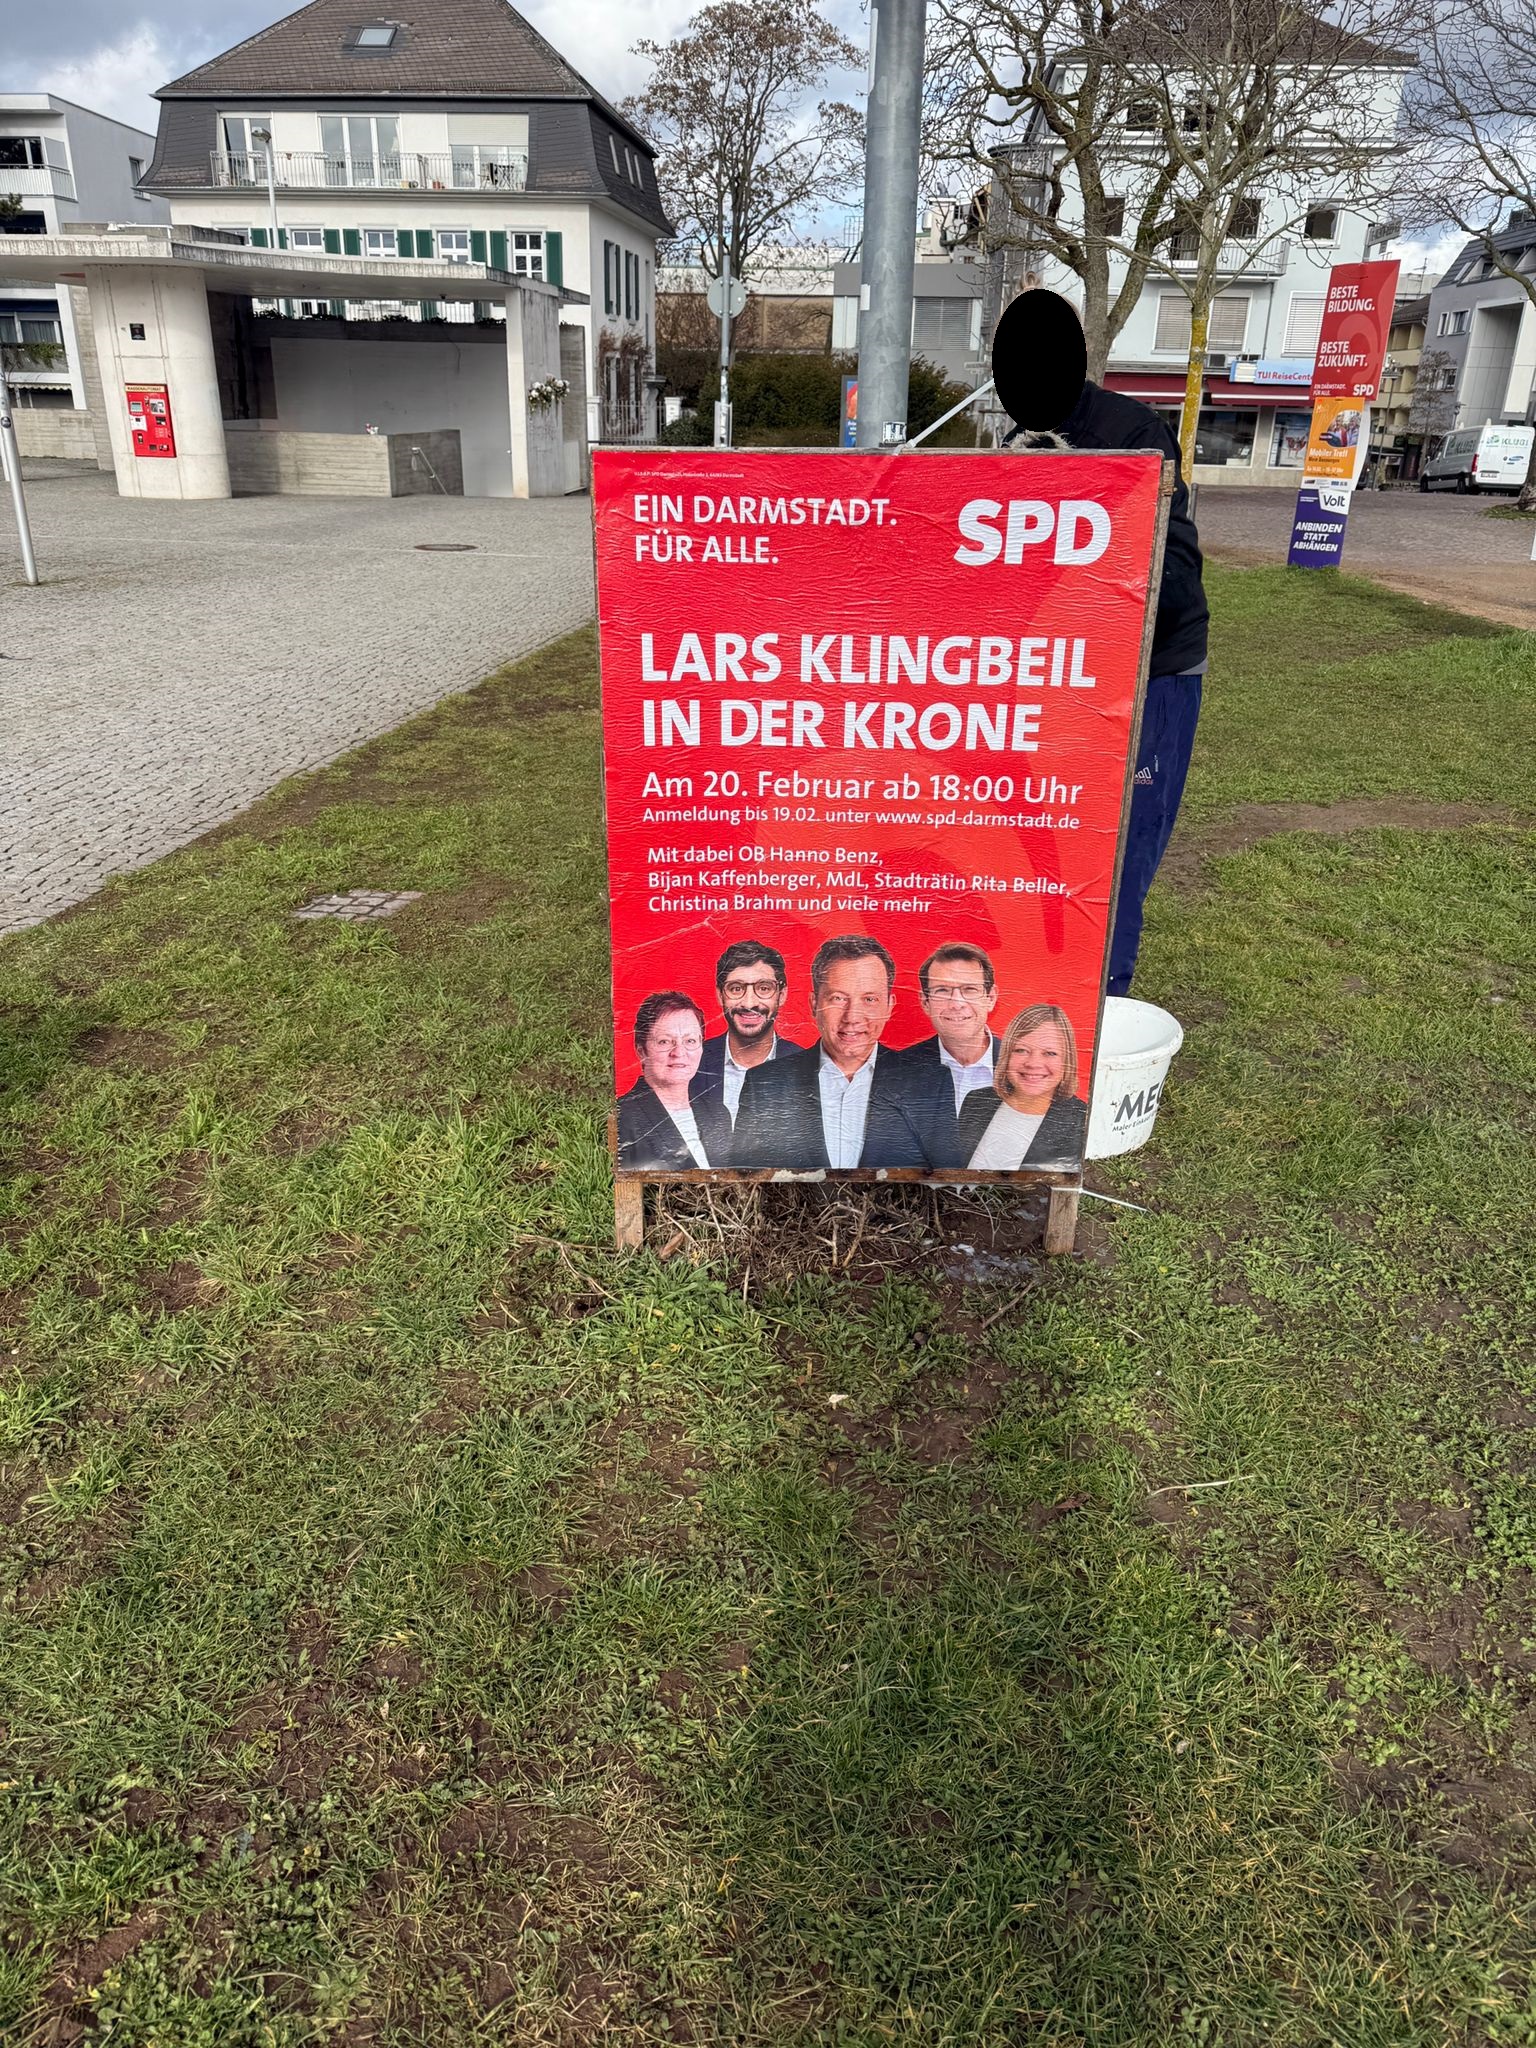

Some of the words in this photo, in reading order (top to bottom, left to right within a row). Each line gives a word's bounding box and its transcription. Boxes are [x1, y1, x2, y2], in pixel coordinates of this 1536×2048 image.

[1330, 285, 1359, 299] BESTE
[1327, 298, 1375, 313] BILDUNG.
[1320, 341, 1350, 354] BESTE
[1317, 354, 1368, 368] ZUKUNFT.
[1258, 371, 1272, 379] TUI
[1353, 384, 1374, 396] SPD
[1324, 495, 1345, 507] Volt
[634, 494, 683, 523] EIN
[693, 495, 898, 526] DARMSTADT.
[953, 497, 1112, 566] SPD
[1295, 522, 1343, 533] ANBINDEN
[1303, 532, 1329, 541] STATT
[635, 532, 693, 563] FÜR
[701, 535, 779, 564] ALLE.
[1293, 541, 1338, 552] ABHÄNGEN
[640, 632, 783, 682] LARS
[800, 634, 1097, 688] KLINGBEIL
[642, 699, 702, 746] IN
[720, 699, 826, 748] DER
[843, 701, 1043, 752] KRONE
[641, 772, 694, 798] Am
[703, 770, 749, 798] 20.
[757, 770, 875, 799] Februar
[882, 773, 921, 800] ab
[929, 775, 1014, 802] 18:00
[1024, 776, 1084, 805] Uhr
[642, 806, 741, 826] Anmeldung
[745, 806, 769, 821] bis
[772, 807, 822, 822] 19.02.
[825, 808, 871, 823] unter
[875, 810, 1081, 830] www.spd-darmstadt.de
[648, 847, 679, 864] Mit
[683, 846, 734, 864] dabei
[738, 846, 765, 863] OB
[770, 848, 830, 864] Hanno
[835, 849, 884, 867] Benz,
[648, 871, 694, 892] Bijan
[698, 870, 821, 892] Kaffenberger,
[826, 872, 869, 891] MdL,
[875, 872, 966, 891] Stadträtin
[972, 875, 1007, 893] Rita
[1013, 876, 1071, 898] Beller,
[648, 896, 729, 912] Christina
[734, 896, 792, 912] Brahm
[798, 896, 832, 912] und
[837, 896, 879, 912] viele
[884, 898, 932, 913] mehr
[1112, 1122, 1131, 1132] Maler
